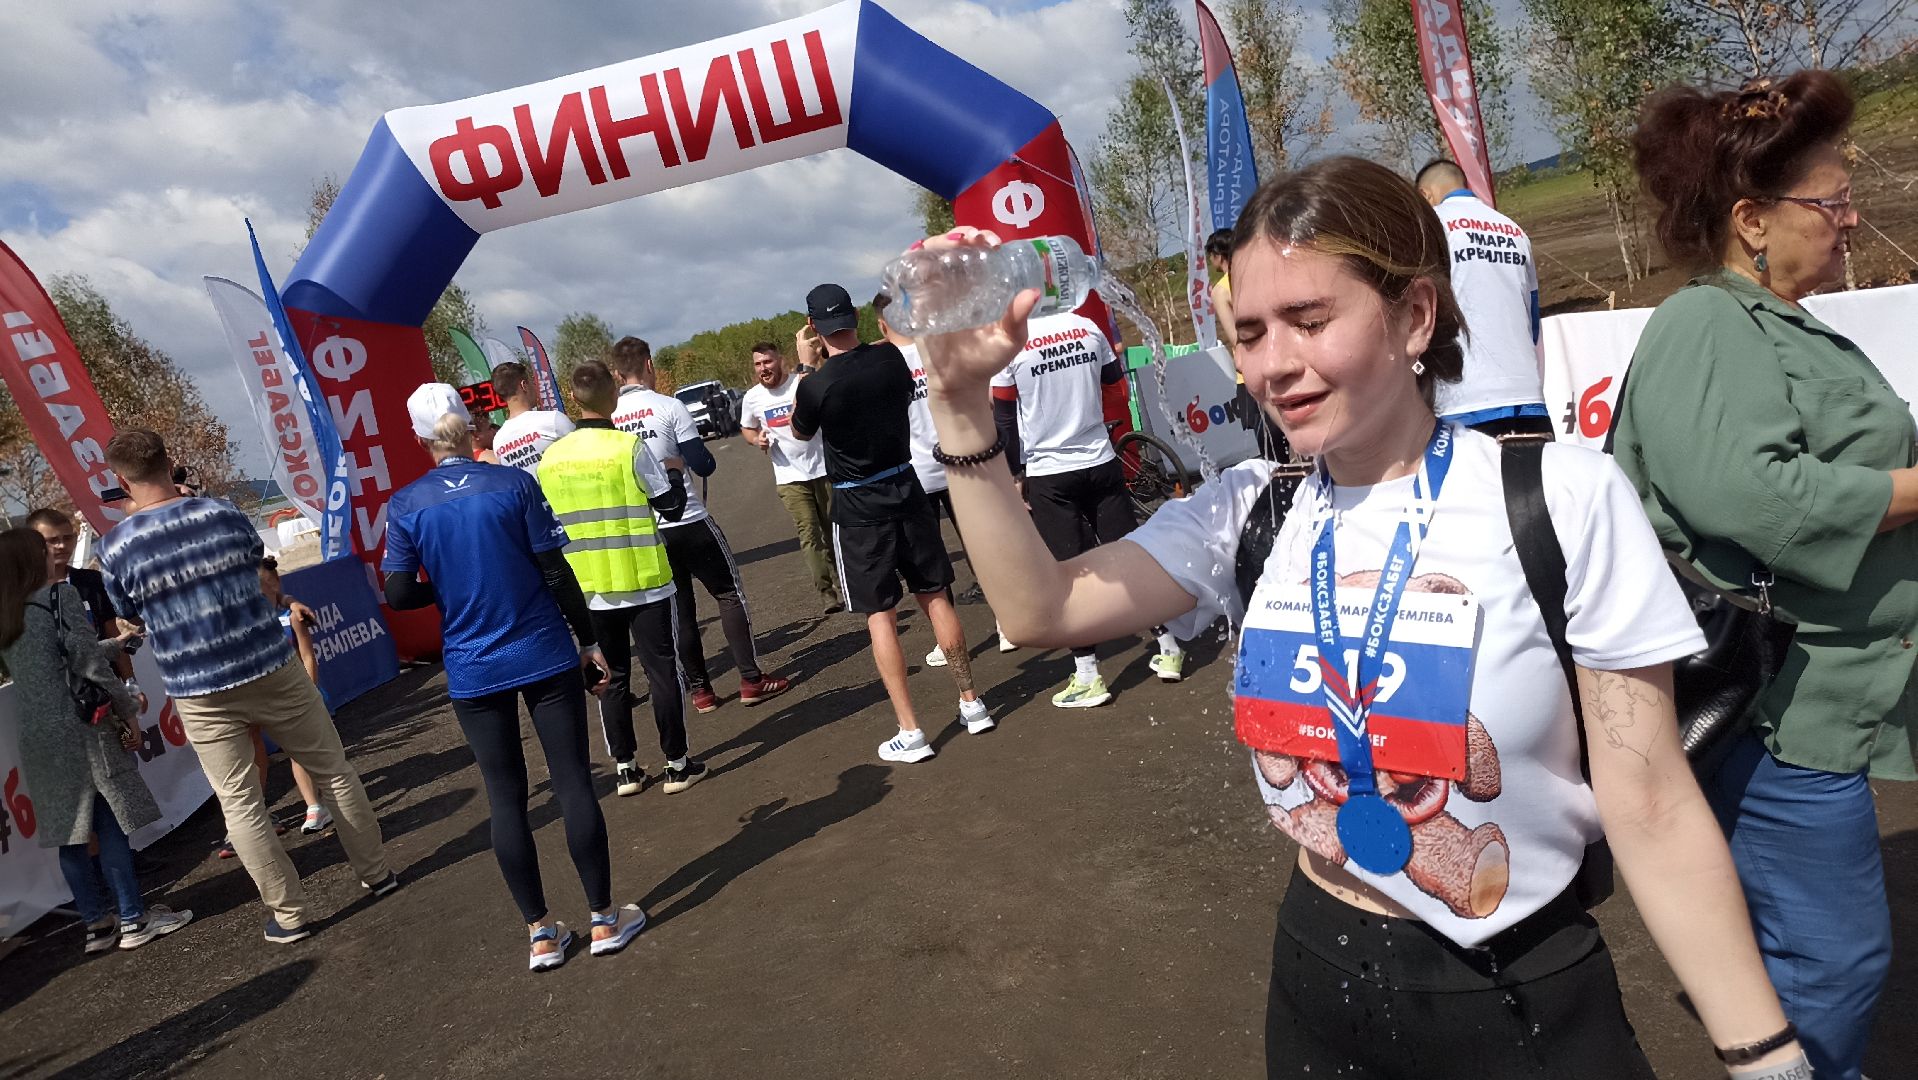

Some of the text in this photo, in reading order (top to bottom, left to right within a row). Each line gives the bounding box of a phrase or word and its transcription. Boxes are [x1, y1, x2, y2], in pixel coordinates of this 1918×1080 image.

[428, 29, 843, 210] ФИНИШ
[1446, 217, 1523, 238] КОМАНДА
[1466, 231, 1517, 249] УМАРА
[1024, 327, 1089, 351] КОМАНДА
[1039, 340, 1085, 360] УМАРА
[1030, 352, 1098, 377] КРЕМЛЕВА
[613, 408, 654, 424] МАНДА
[619, 420, 645, 433] АРА
[504, 445, 537, 464] УМАРА
[312, 334, 392, 605] ФИНИ
[1316, 551, 1335, 646] #БОКСЗАБЕГ
[1364, 554, 1405, 659] #БОКСЗАБЕГ
[1265, 600, 1454, 624] КОМАН МАР ЕМЛЕВА
[312, 617, 386, 665] РЕМЛЕВА
[1290, 644, 1407, 703] 519
